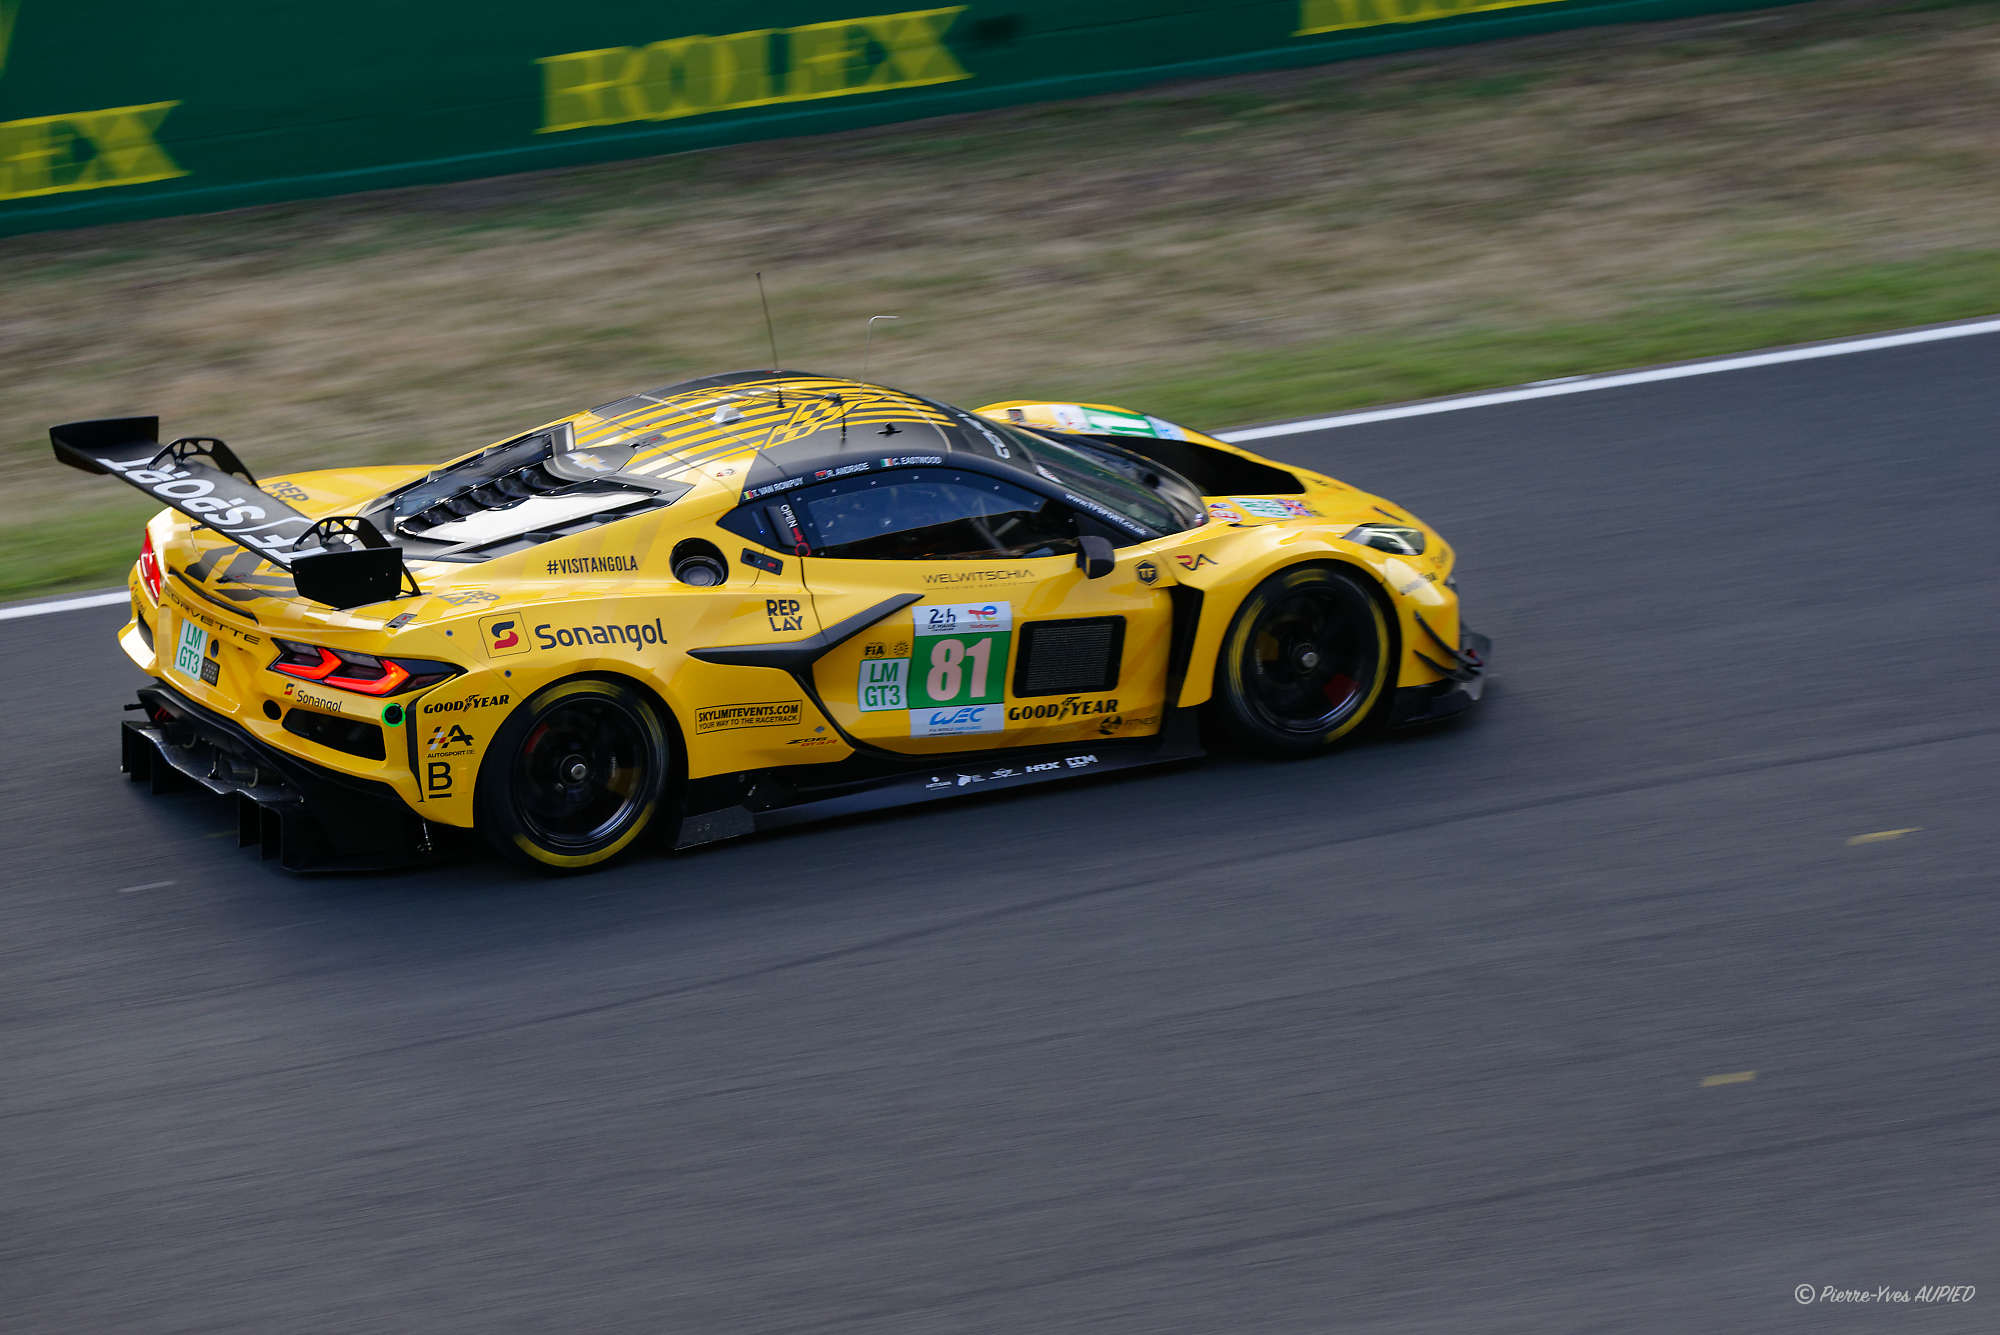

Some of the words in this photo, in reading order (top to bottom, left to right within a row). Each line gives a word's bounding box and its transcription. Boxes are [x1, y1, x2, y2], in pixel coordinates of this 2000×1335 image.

[533, 4, 976, 134] ROLEX
[780, 503, 799, 528] OPEN
[546, 555, 639, 575] #VISITANGOLA
[922, 569, 1035, 584] WELWITSCHIA
[163, 585, 262, 646] CORVETTE
[766, 599, 801, 616] REP
[769, 615, 803, 632] LAY
[185, 623, 203, 650] LM
[534, 617, 668, 652] Sonangol
[179, 645, 201, 676] GT3
[926, 637, 993, 702] 81
[869, 662, 899, 683] LM
[297, 690, 342, 712] Sonangol
[423, 694, 510, 714] GOODYEAR
[864, 684, 901, 708] GT3
[698, 704, 799, 722] SKYLIMITEVENTS.COM
[755, 714, 798, 724] RACETRACK
[929, 707, 985, 726] WEC
[1008, 696, 1119, 721] GOODYEAR
[427, 750, 465, 759] AUTOSPORT
